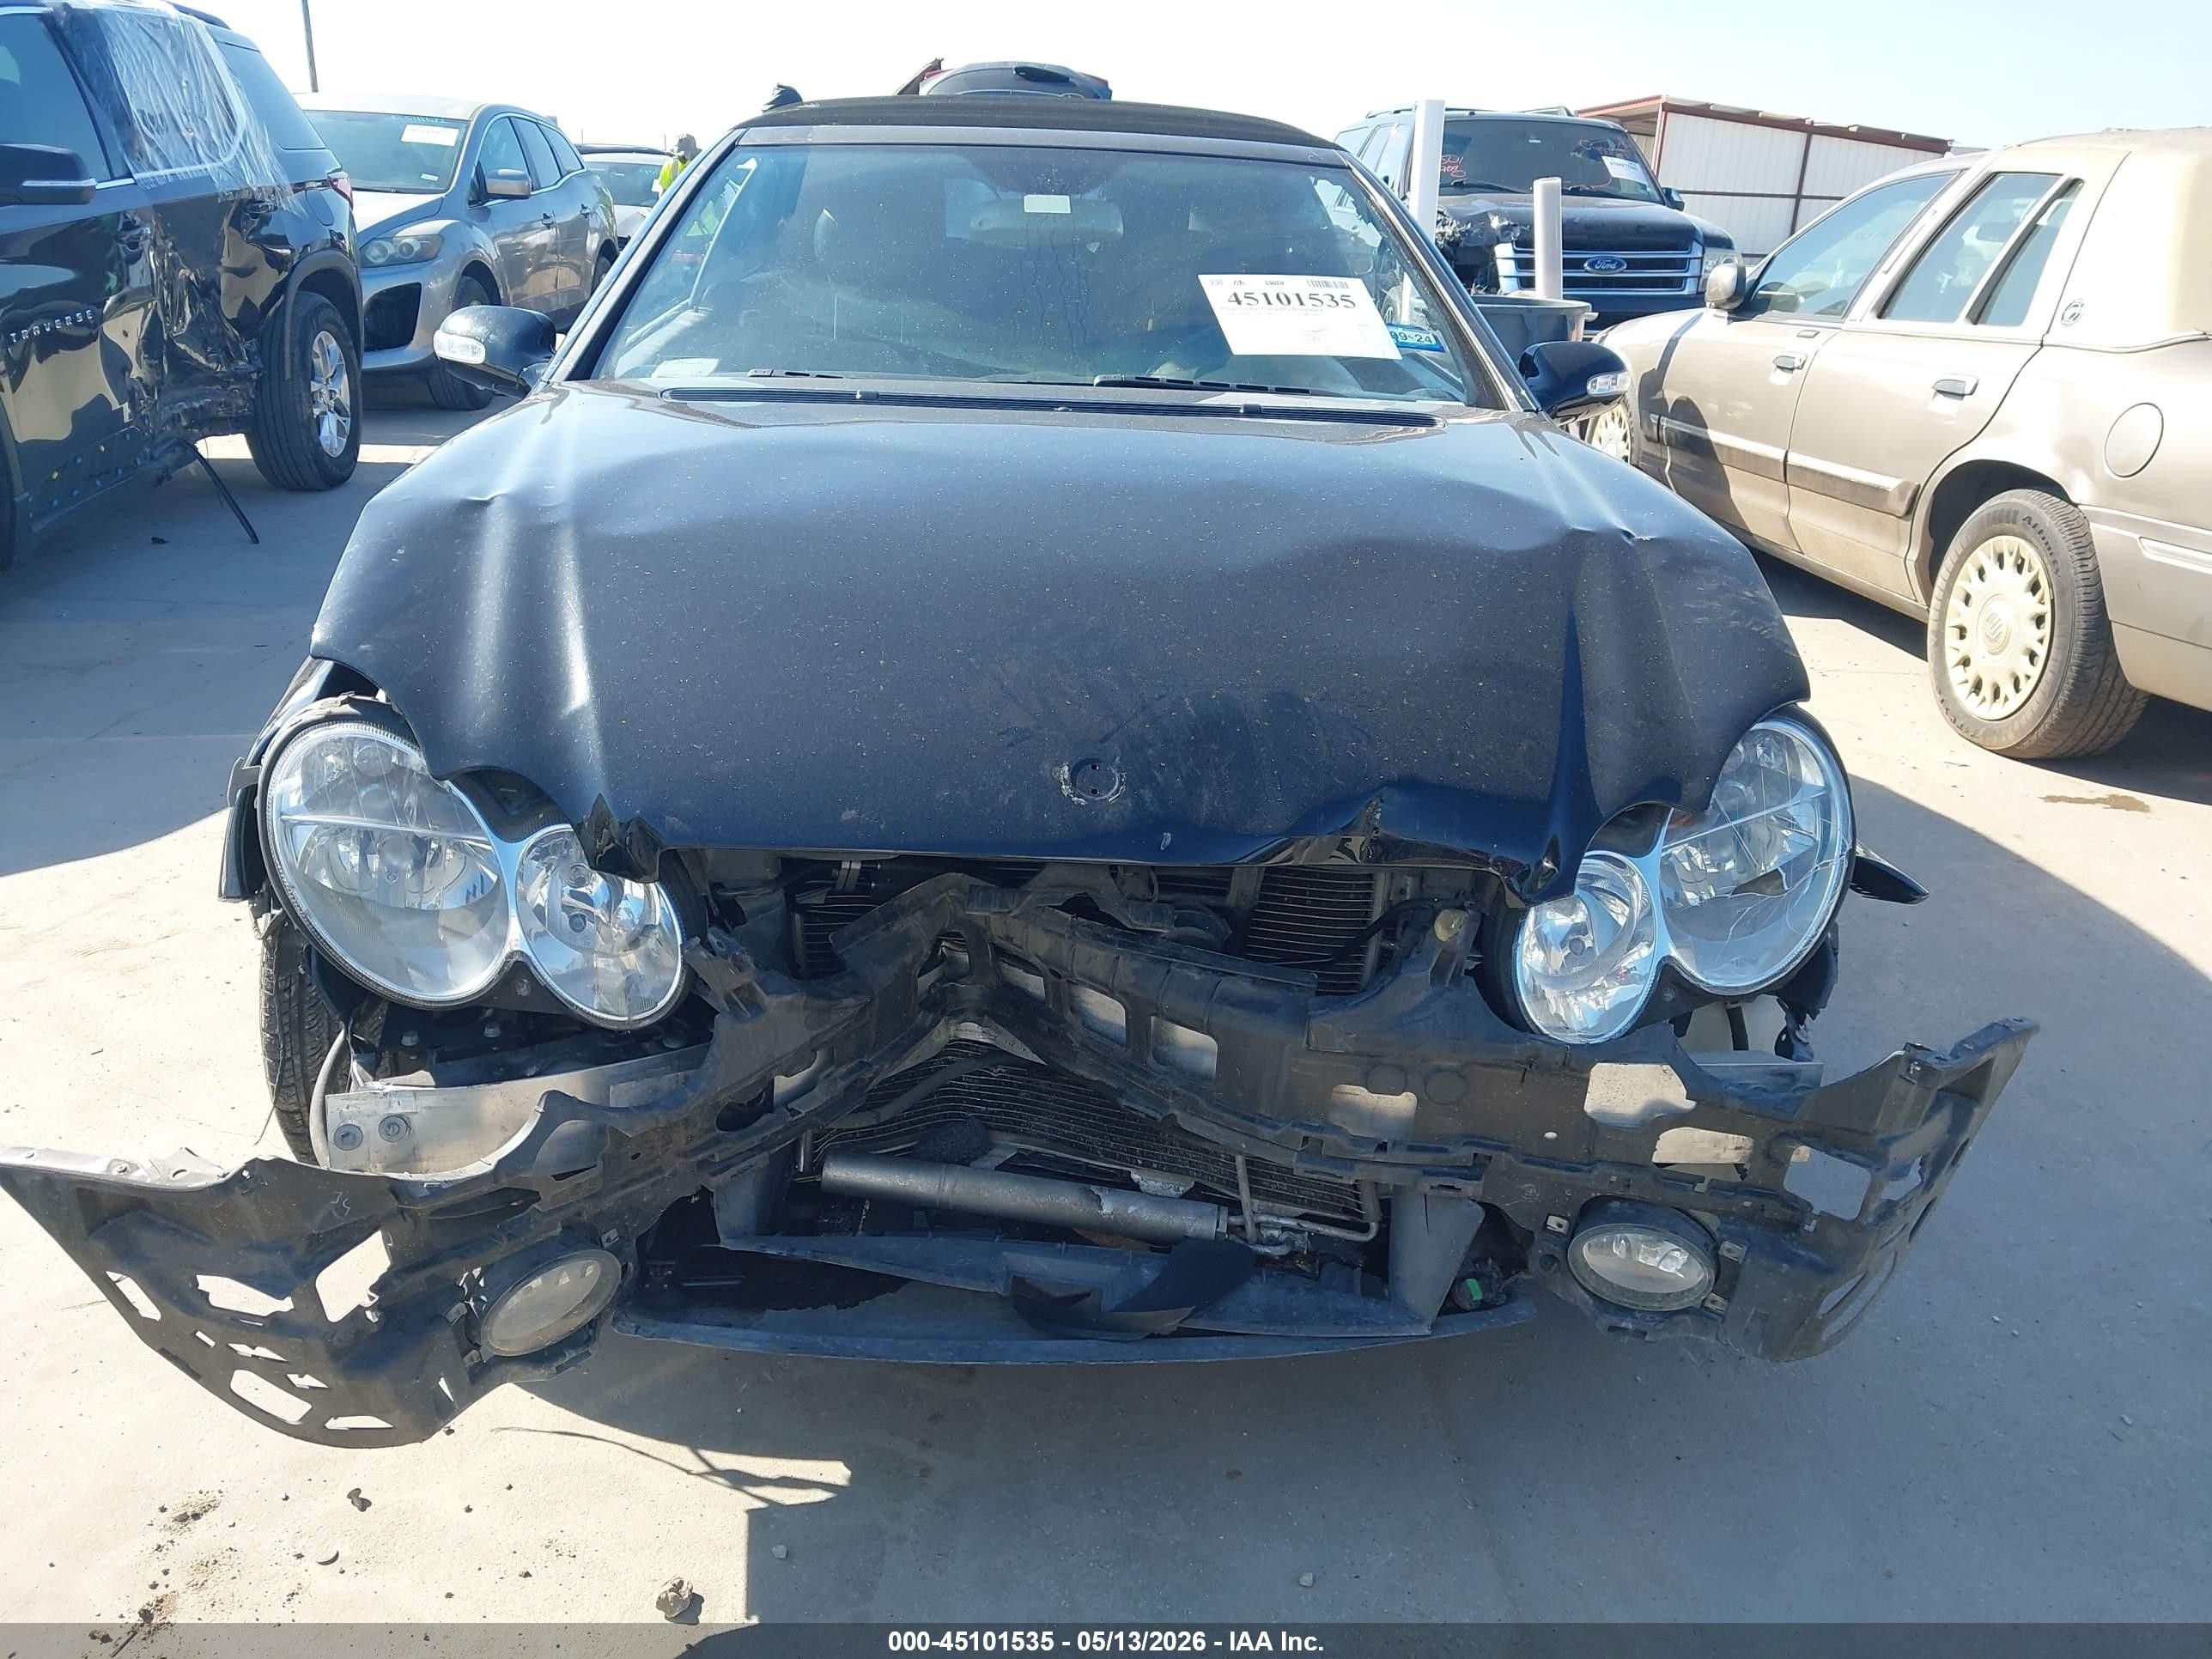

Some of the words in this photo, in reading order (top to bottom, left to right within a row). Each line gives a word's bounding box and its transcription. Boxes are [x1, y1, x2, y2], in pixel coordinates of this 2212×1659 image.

[1595, 259, 1618, 270] Ford
[1228, 291, 1356, 309] 45101535
[9, 310, 94, 343] TRAVERSE
